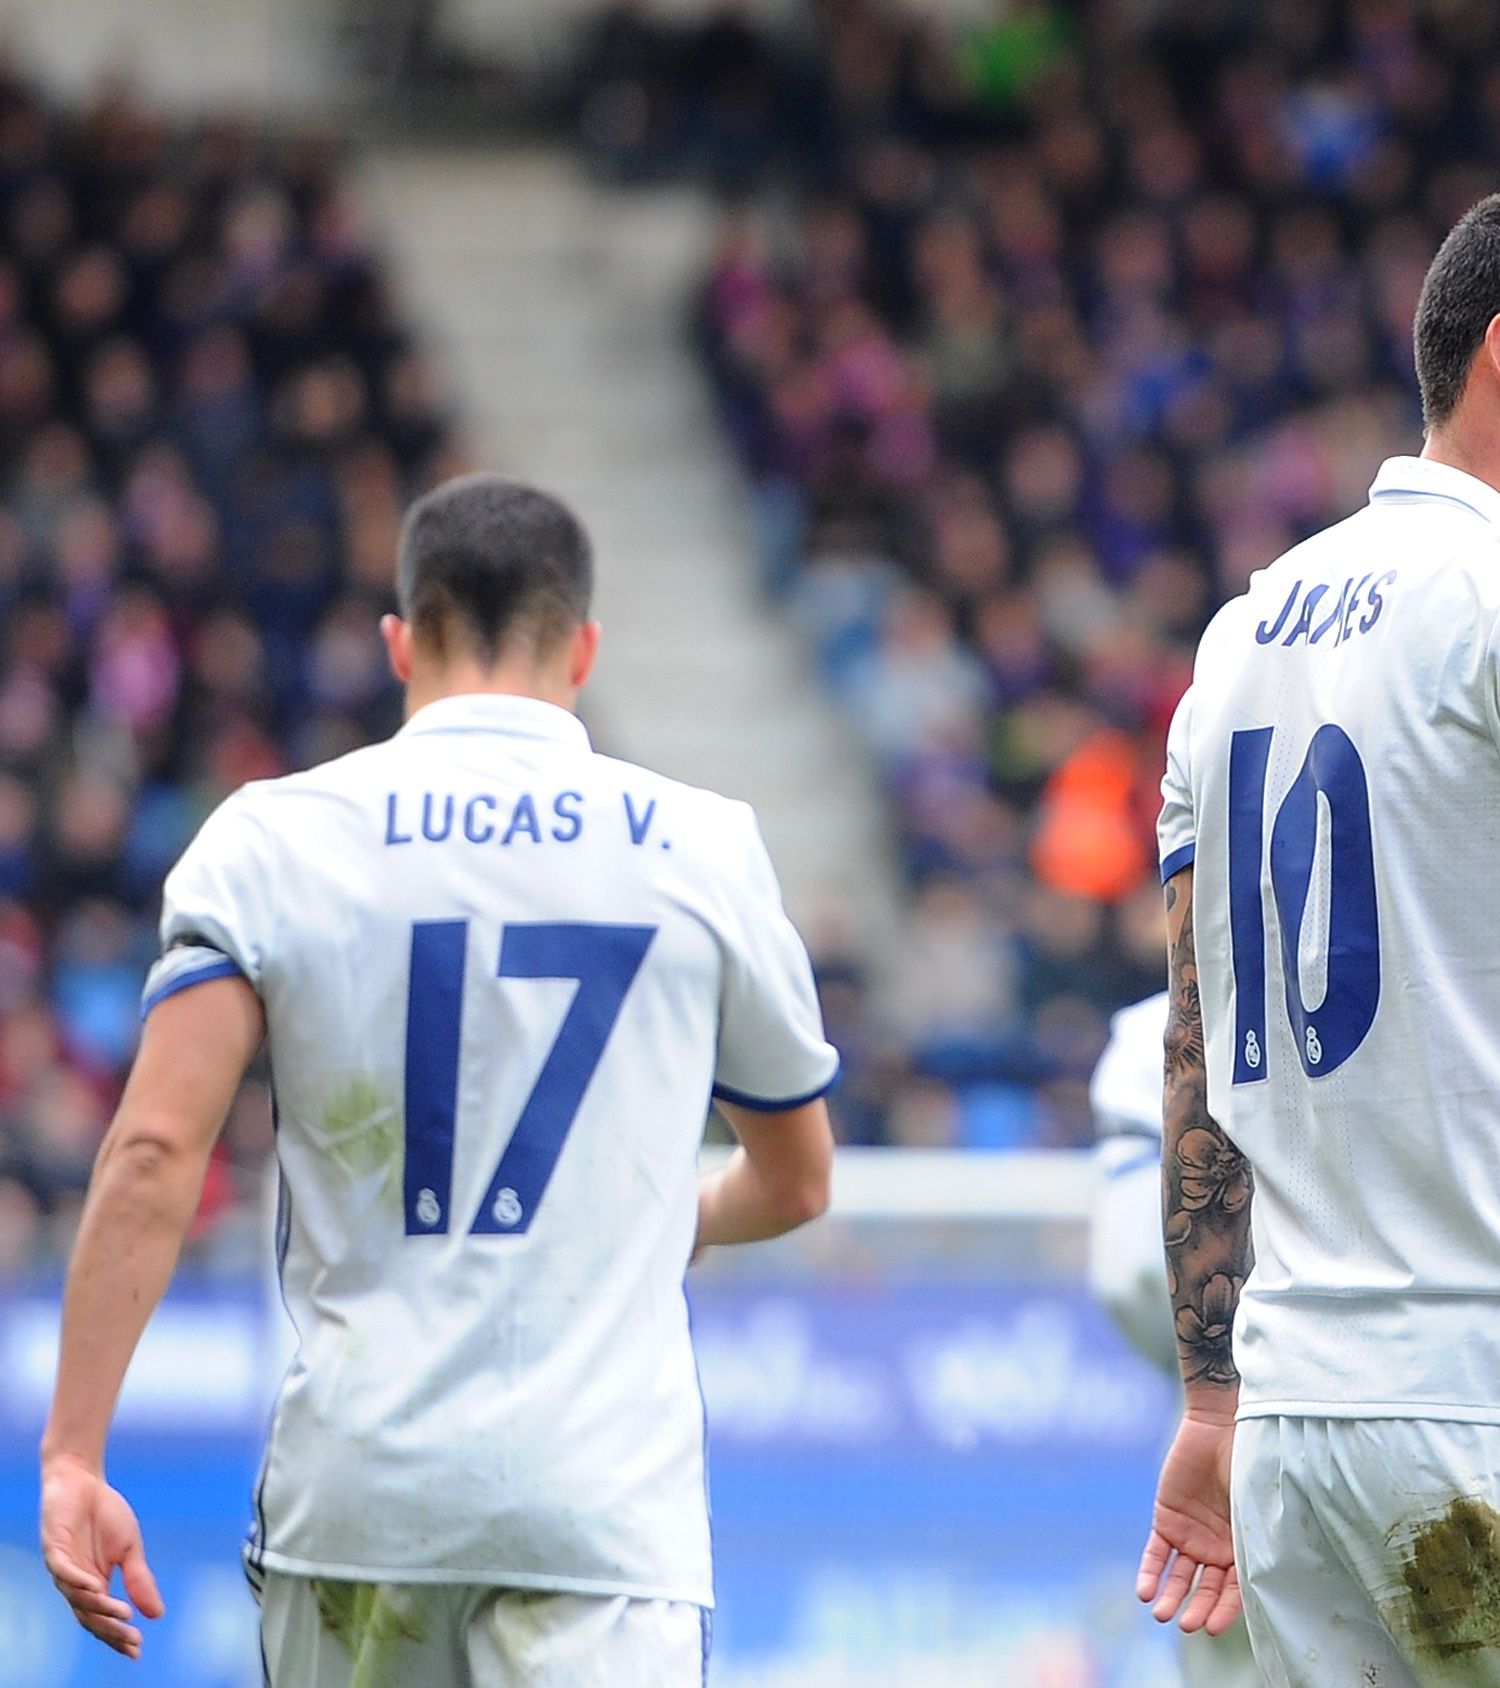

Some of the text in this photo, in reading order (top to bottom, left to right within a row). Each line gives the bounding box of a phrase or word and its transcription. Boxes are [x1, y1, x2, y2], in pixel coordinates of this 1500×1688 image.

[383, 790, 673, 850] LUCAS V.
[1228, 723, 1381, 1085] 10
[404, 918, 659, 1237] 17
